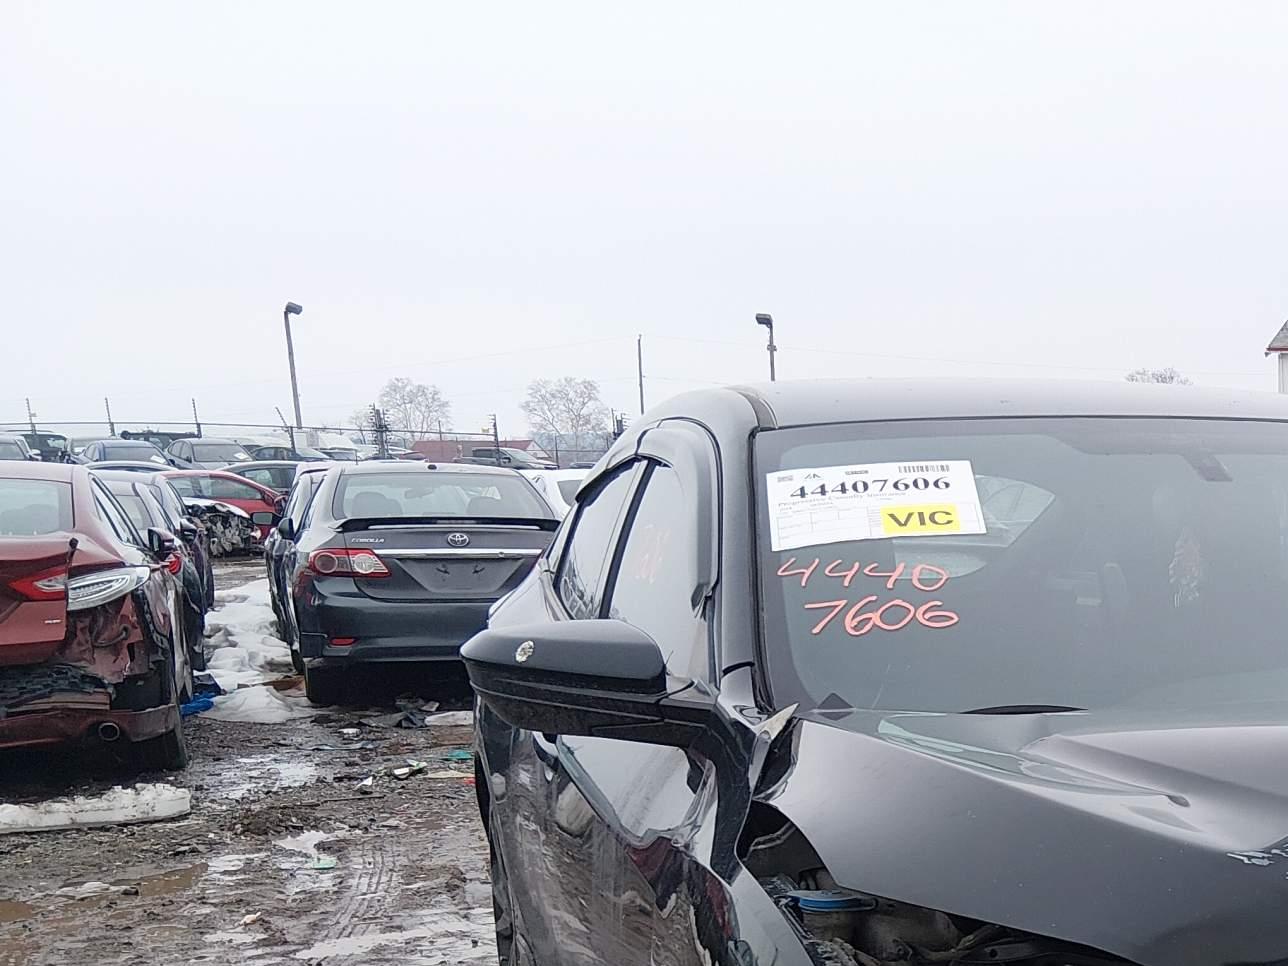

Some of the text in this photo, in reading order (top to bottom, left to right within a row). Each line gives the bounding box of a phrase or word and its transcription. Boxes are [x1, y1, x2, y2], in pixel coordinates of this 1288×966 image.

[789, 475, 951, 499] 44407606
[887, 510, 954, 528] VIC
[777, 557, 950, 592] 4440
[804, 595, 960, 636] 7606
